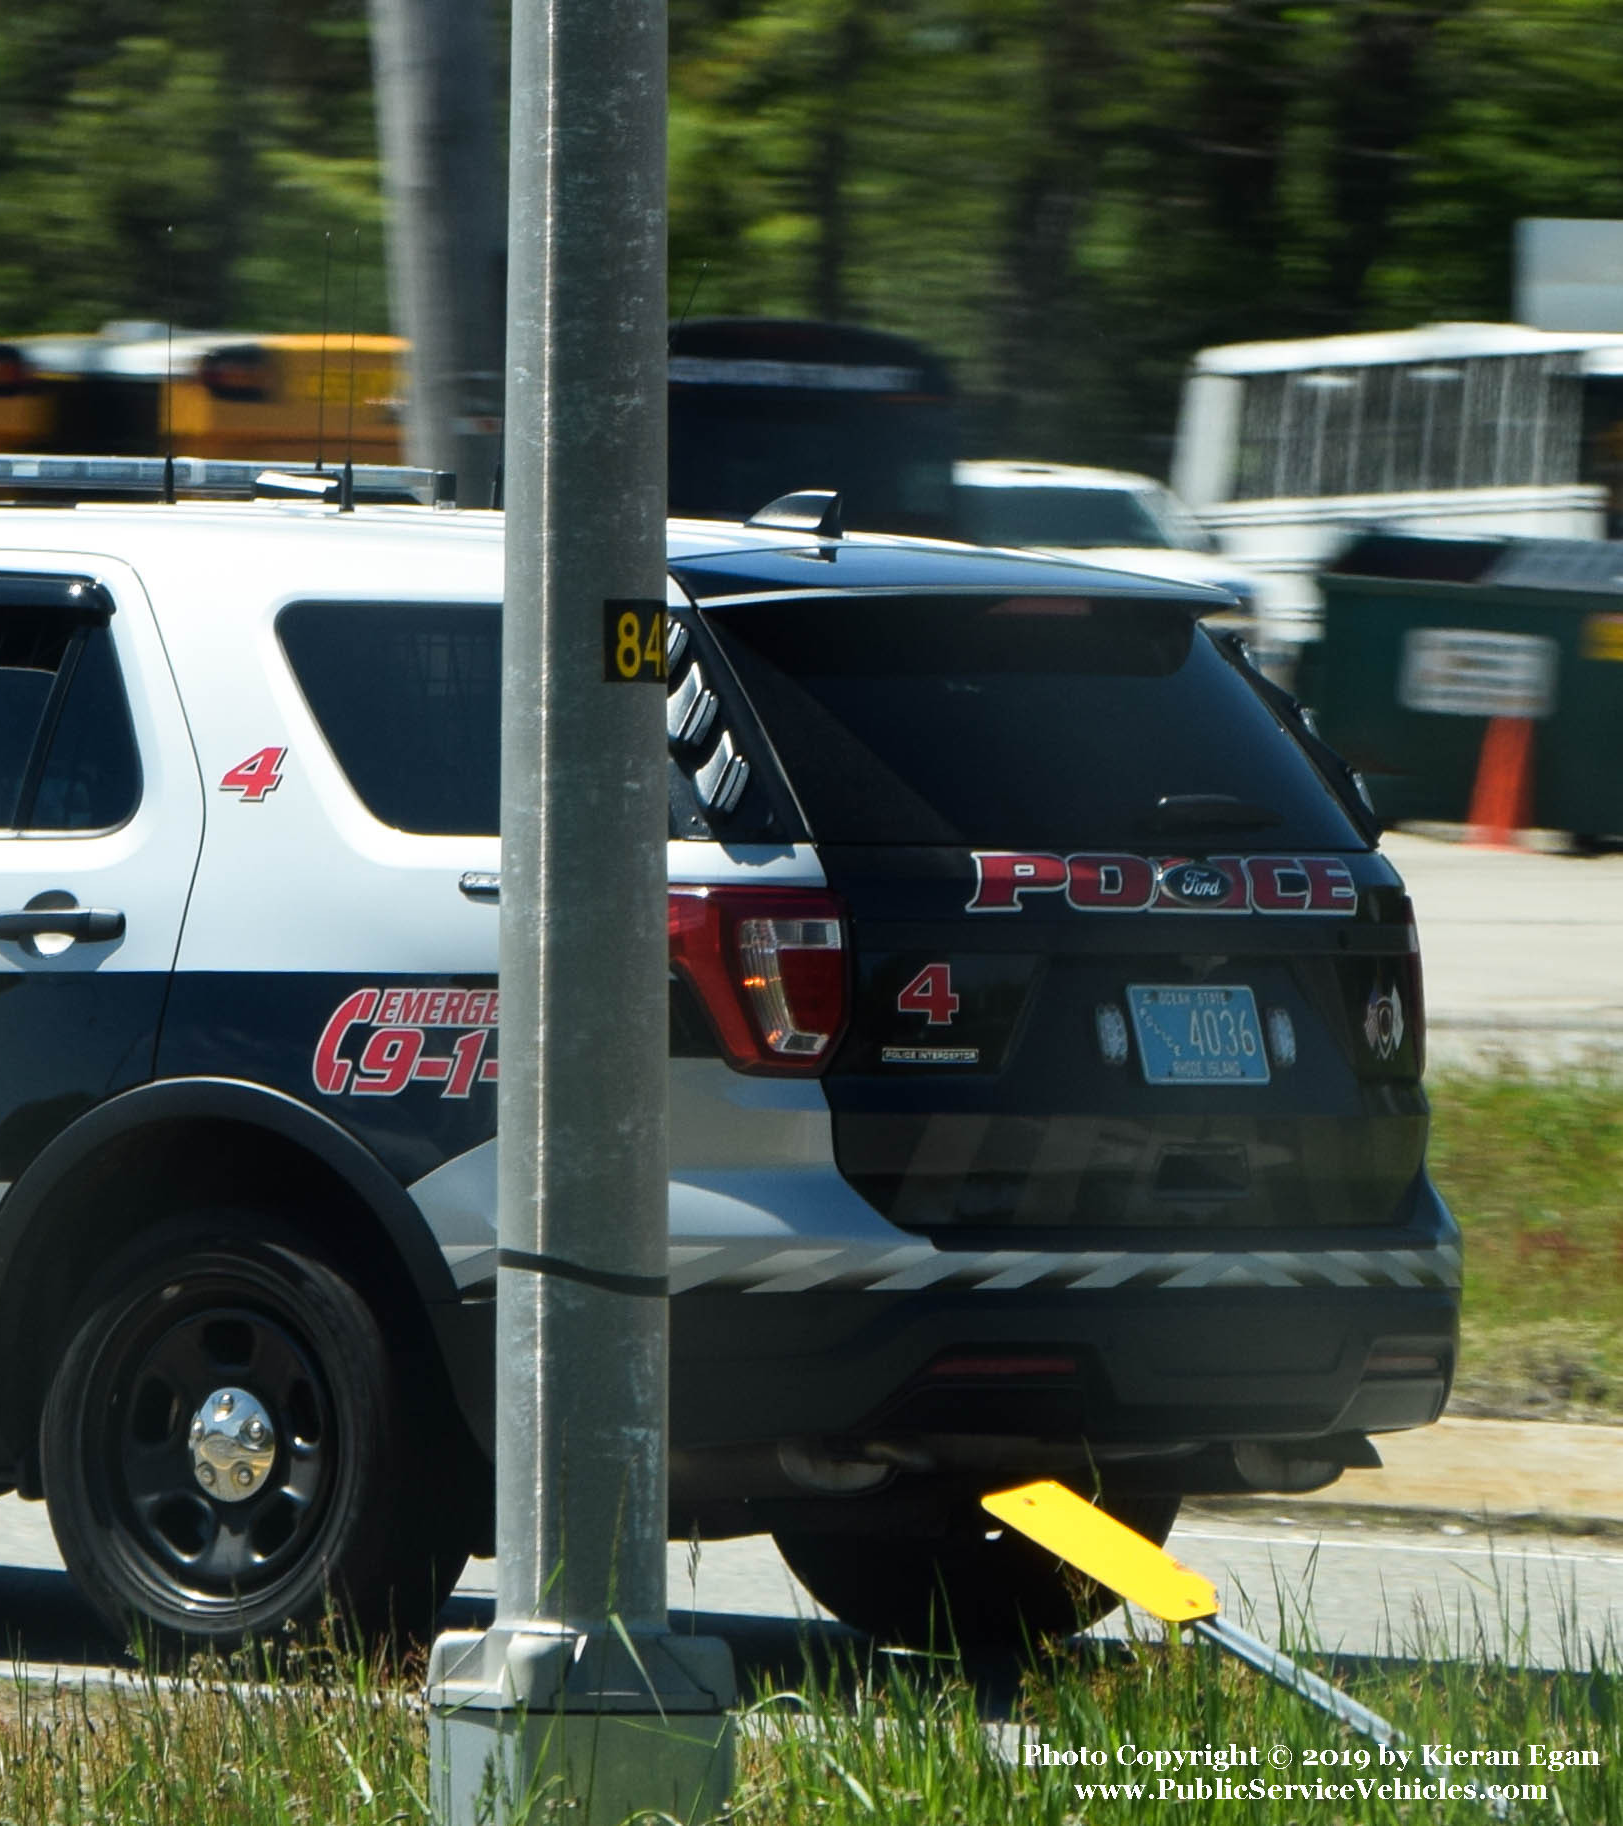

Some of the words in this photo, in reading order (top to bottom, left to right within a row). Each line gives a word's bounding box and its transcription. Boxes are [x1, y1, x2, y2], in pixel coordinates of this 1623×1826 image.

[219, 746, 288, 802] 4
[1182, 869, 1221, 896] Ford
[898, 963, 959, 1026] 4
[1196, 991, 1227, 1006] STATE
[1190, 1008, 1257, 1057] 4036
[1173, 1060, 1201, 1076] RHODE
[1208, 1061, 1241, 1077] ISLAND
